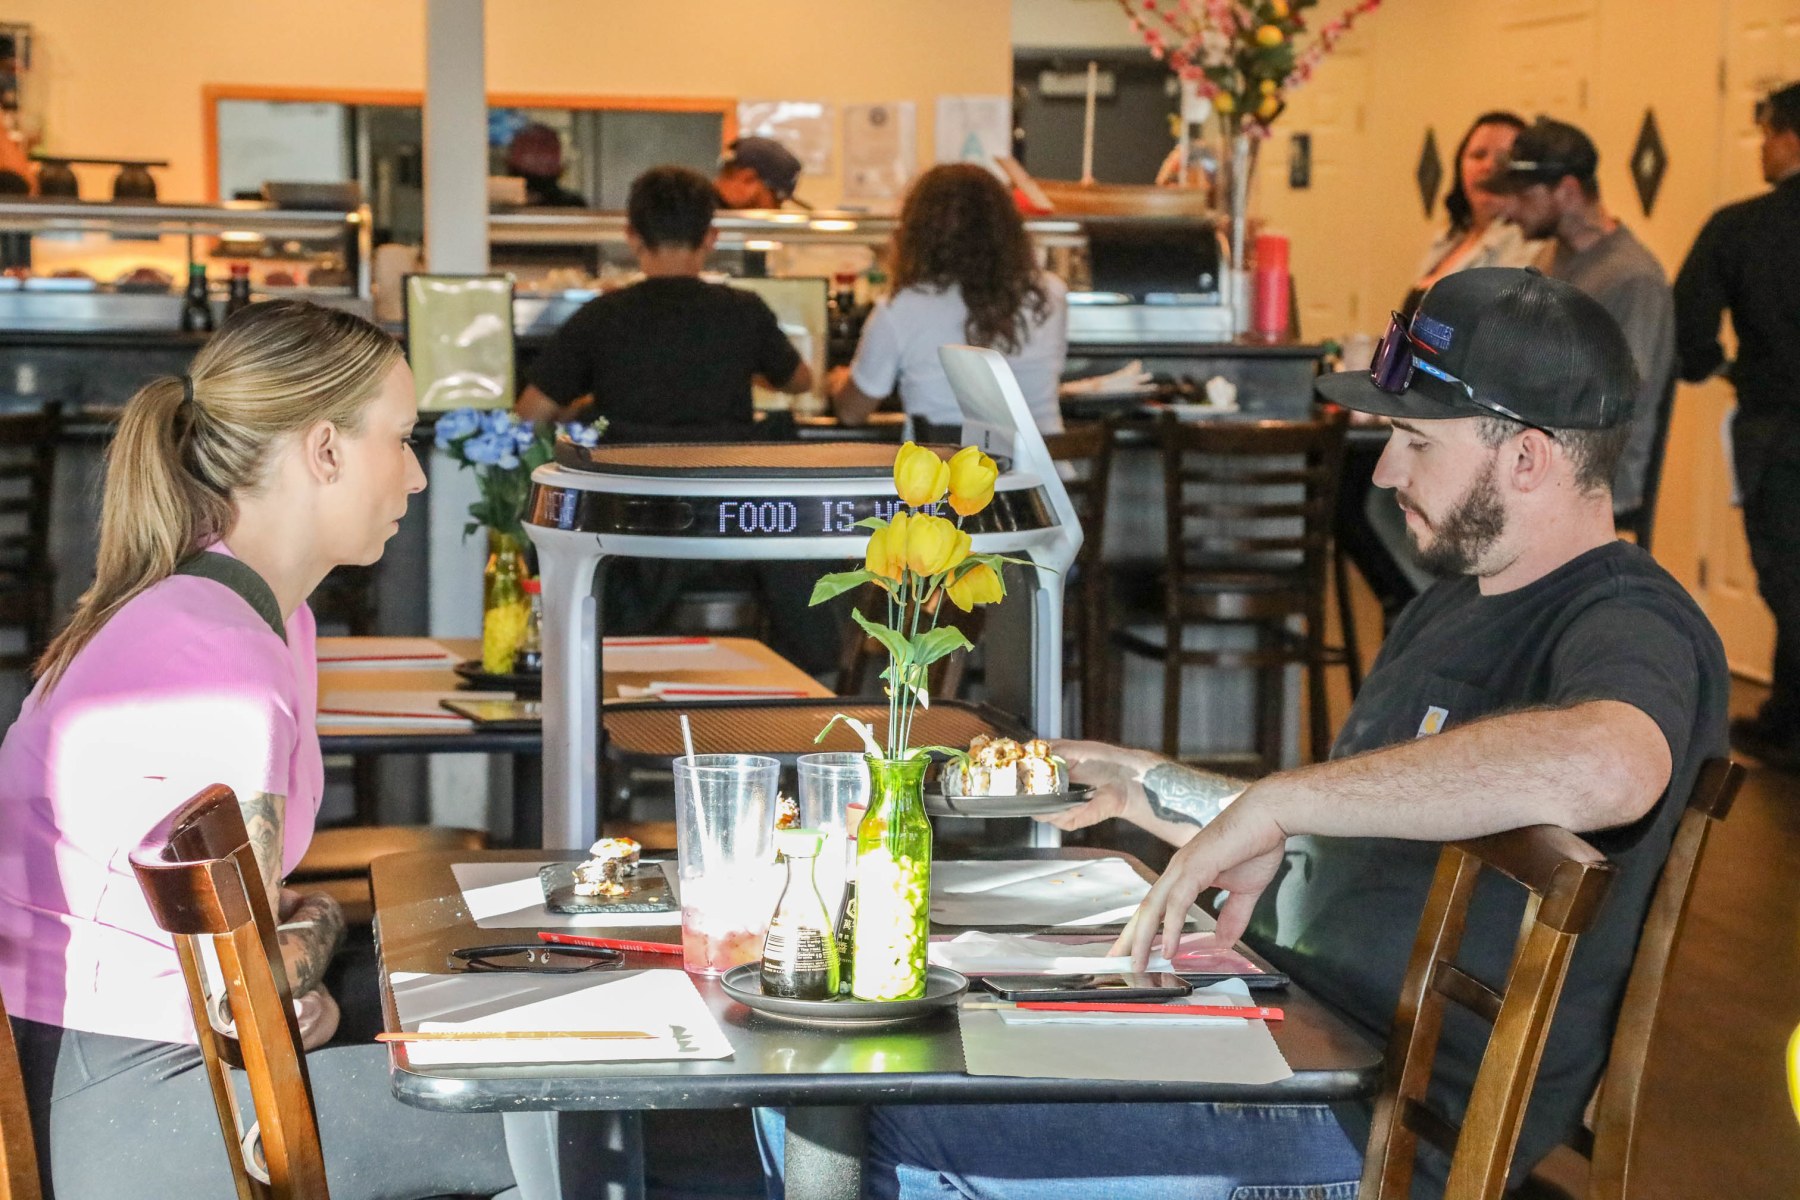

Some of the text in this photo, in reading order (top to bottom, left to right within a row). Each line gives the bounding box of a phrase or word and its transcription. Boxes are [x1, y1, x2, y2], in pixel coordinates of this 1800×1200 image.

[719, 500, 948, 533] FOOD IS HE
